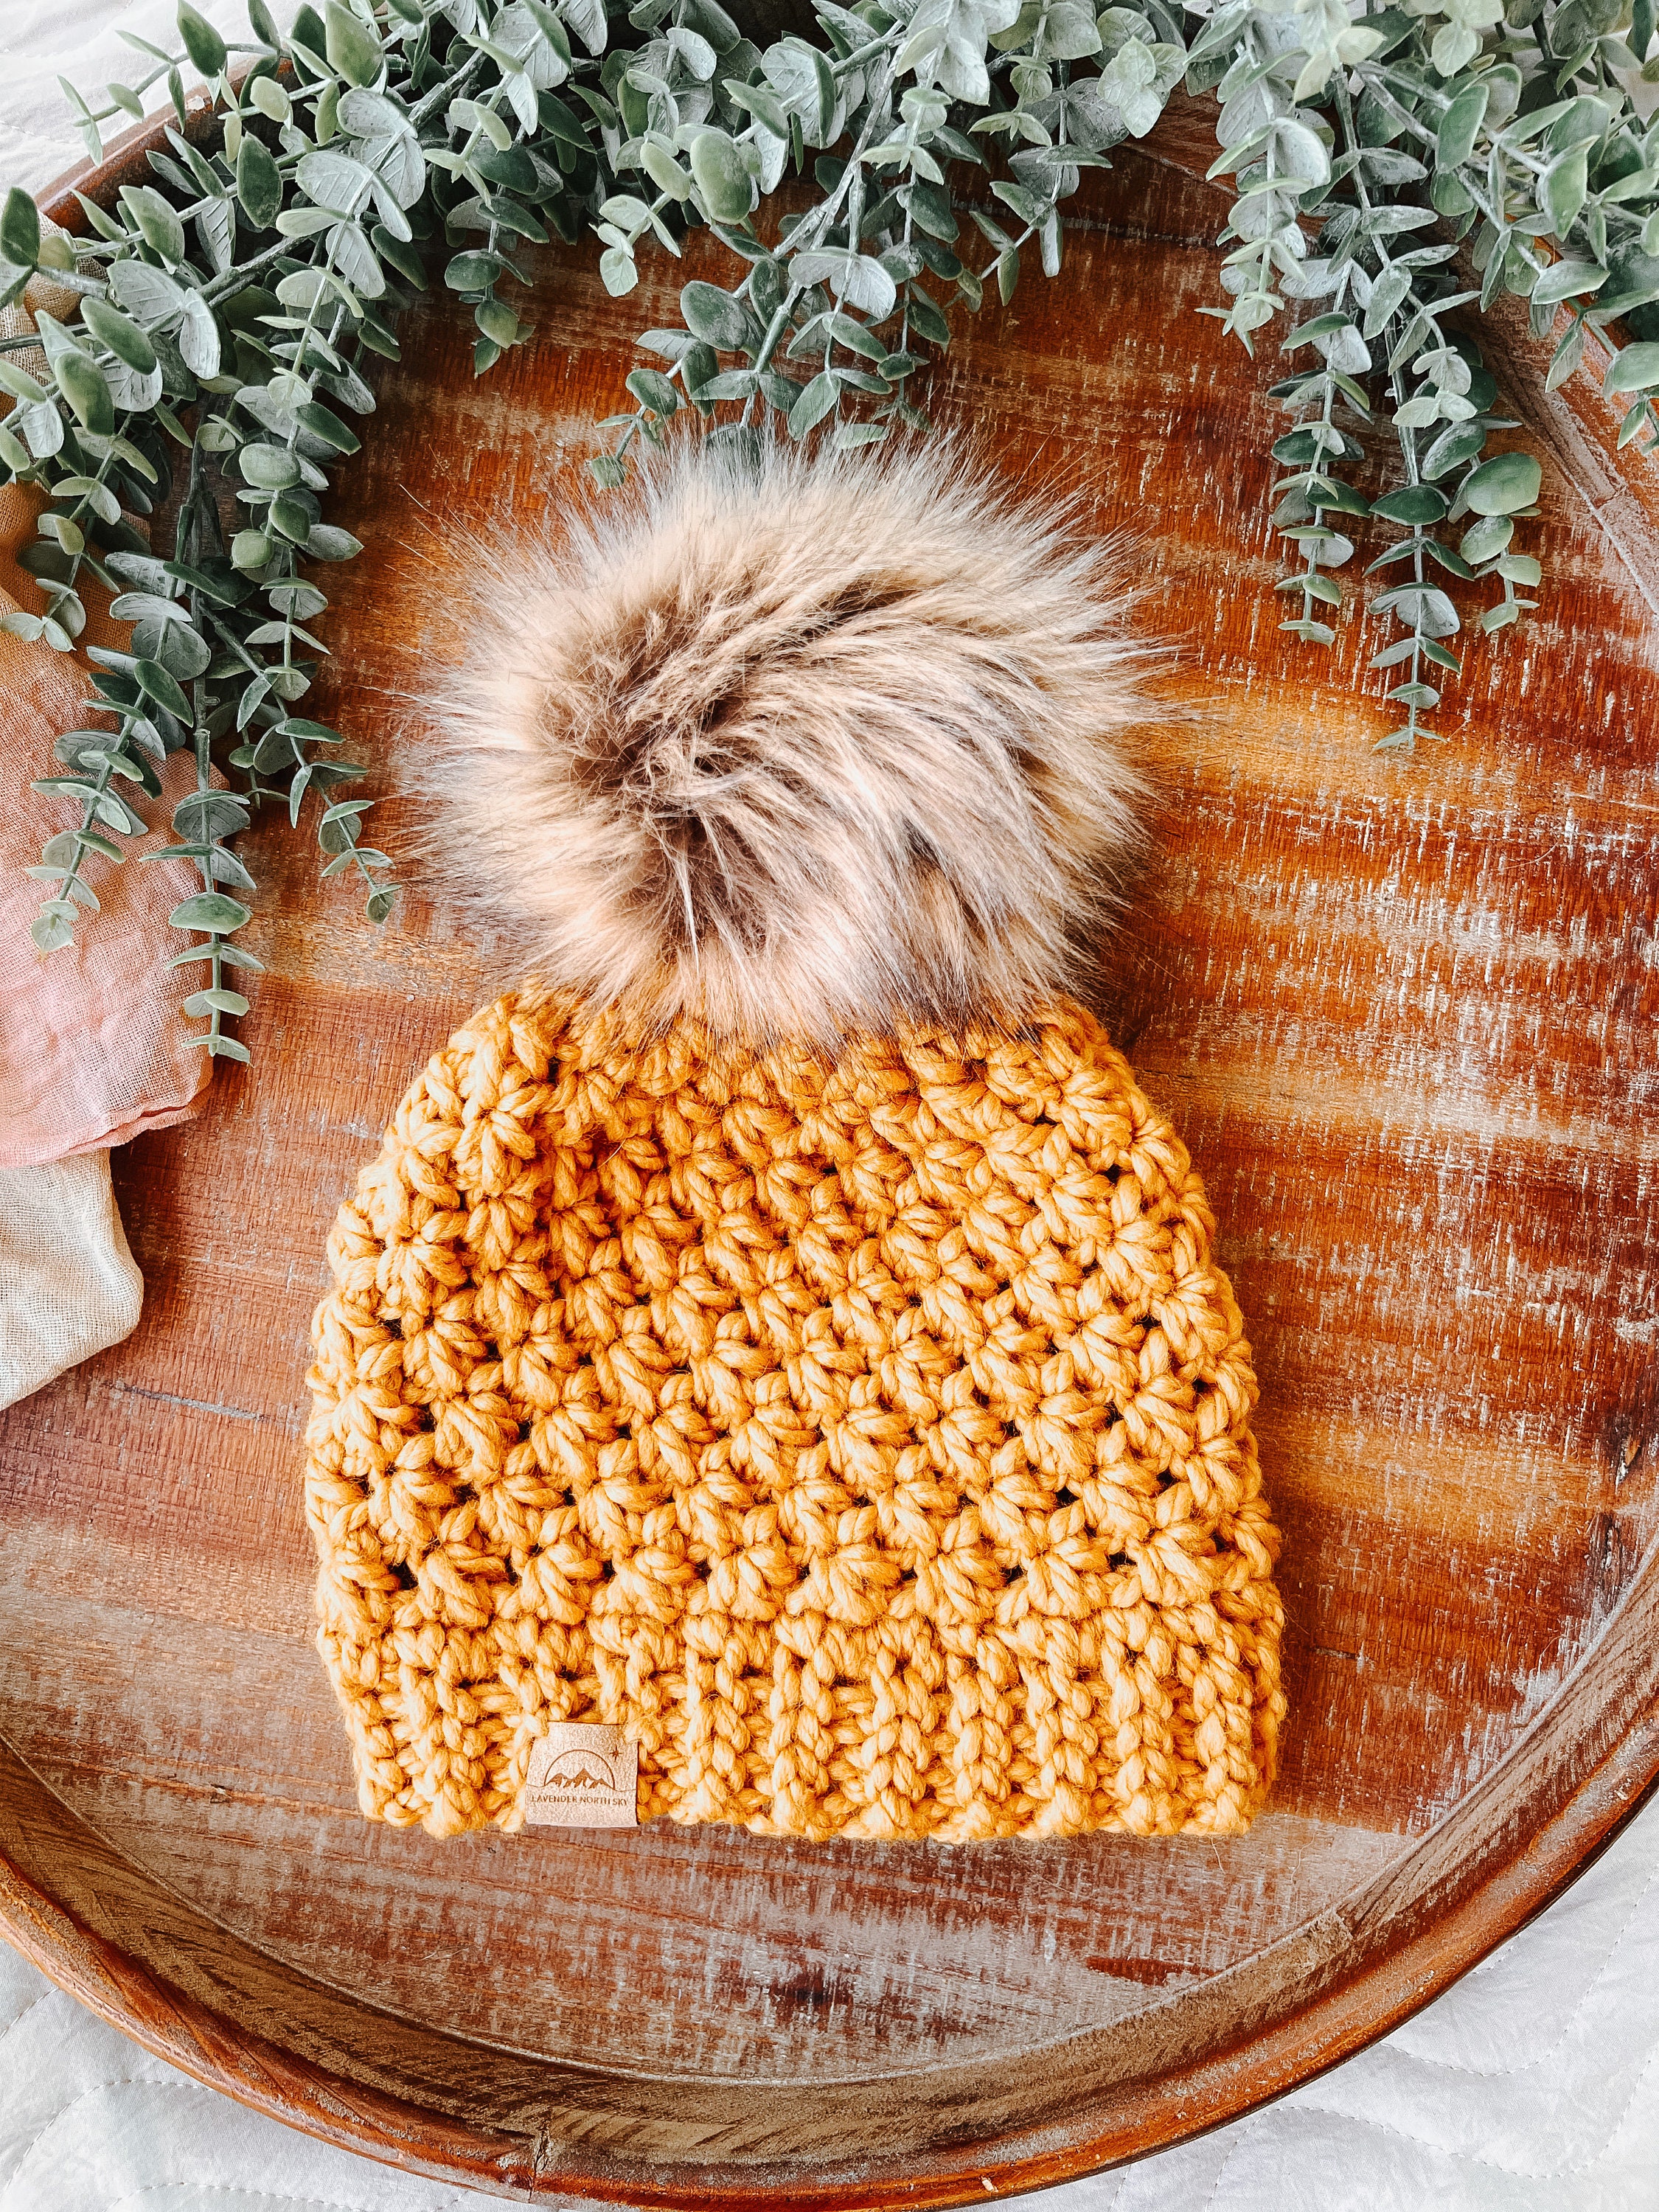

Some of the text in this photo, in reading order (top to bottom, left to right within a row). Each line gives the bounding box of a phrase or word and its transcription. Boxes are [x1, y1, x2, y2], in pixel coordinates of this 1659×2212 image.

[531, 1795, 627, 1806] LAVENDER NORTH SKY
